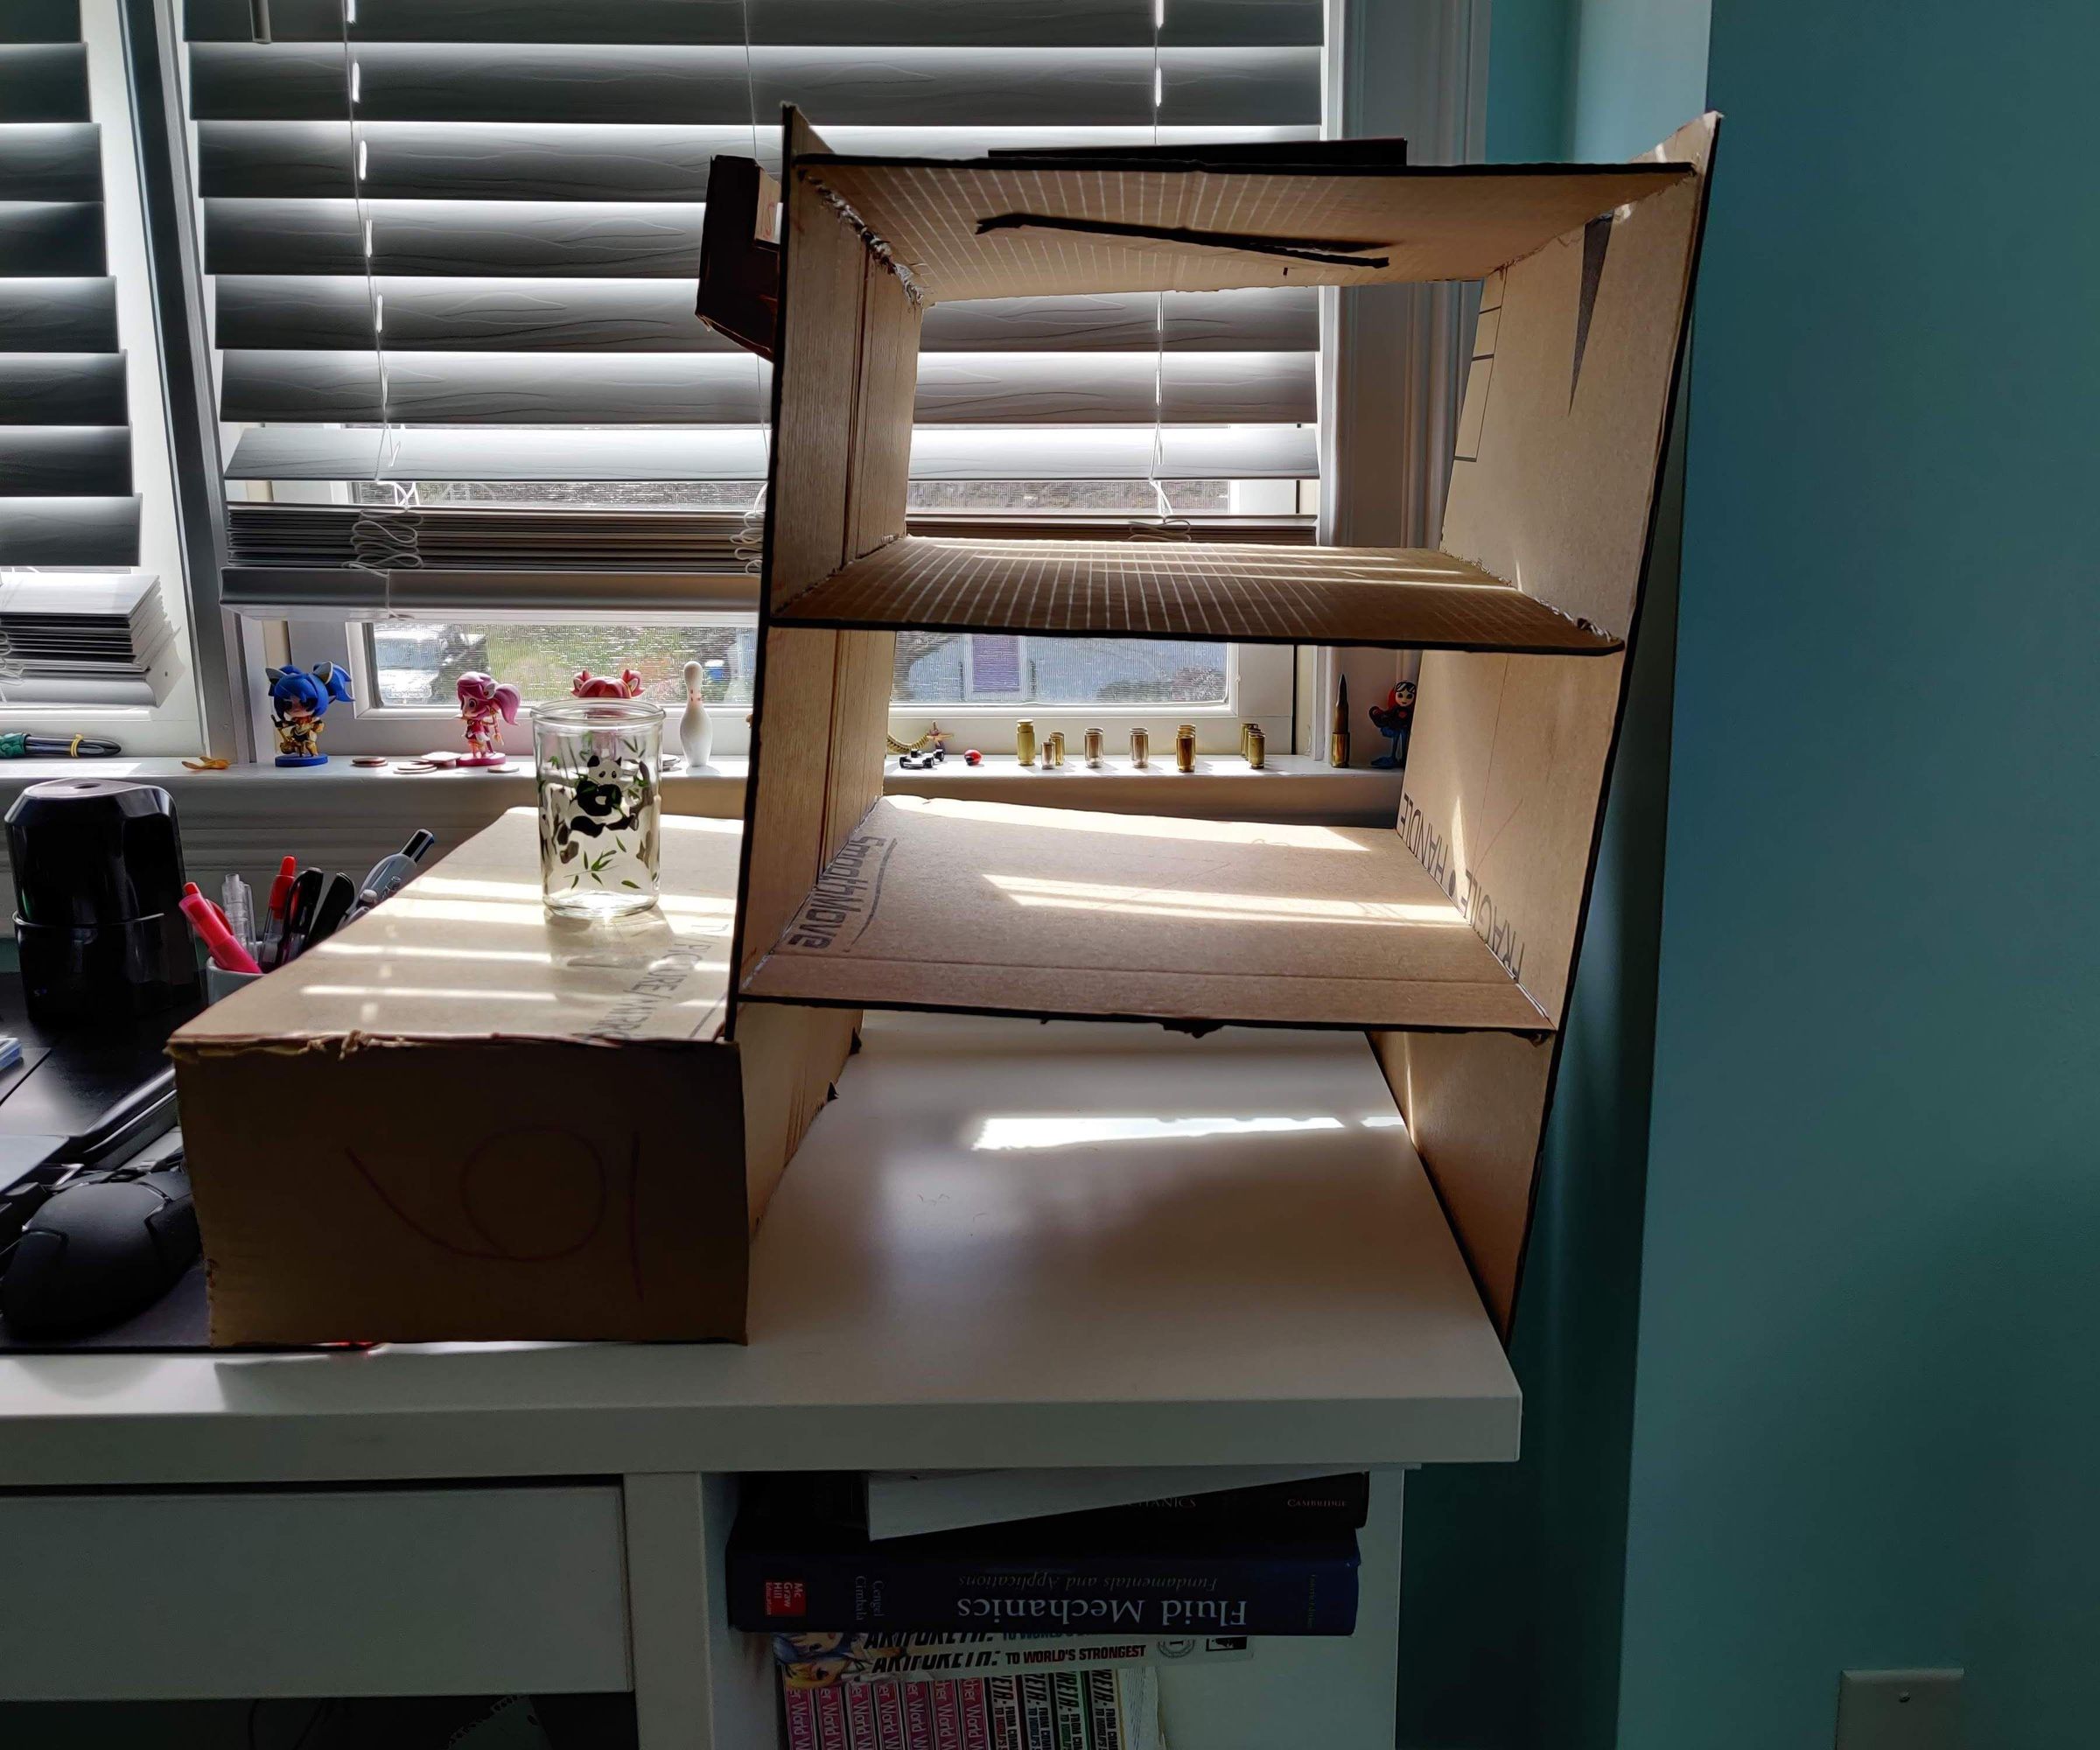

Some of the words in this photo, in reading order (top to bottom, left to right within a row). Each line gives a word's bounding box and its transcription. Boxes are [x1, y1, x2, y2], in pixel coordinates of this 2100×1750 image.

[1400, 793, 1449, 886] HANDLE
[773, 1582, 783, 1600] Hill
[783, 1582, 794, 1608] Graw
[958, 1572, 1060, 1592] Applications
[1065, 1574, 1098, 1592] and
[1103, 1573, 1219, 1592] Fundamentals
[956, 1596, 1150, 1626] Mechanics
[1160, 1597, 1249, 1628] Fluid
[1005, 1652, 1020, 1665] TO
[1023, 1649, 1076, 1663] WORLD'S
[1079, 1645, 1147, 1661] STRONGEST
[792, 1701, 811, 1735] World
[822, 1701, 841, 1736] World
[853, 1700, 871, 1735] World
[880, 1699, 899, 1733] World
[909, 1698, 927, 1732] World
[938, 1703, 956, 1737] World
[965, 1704, 984, 1738] World
[1006, 1706, 1018, 1726] FROM
[1039, 1707, 1050, 1727] FROM
[1070, 1713, 1082, 1734] FROM
[1106, 1708, 1116, 1728] FROM
